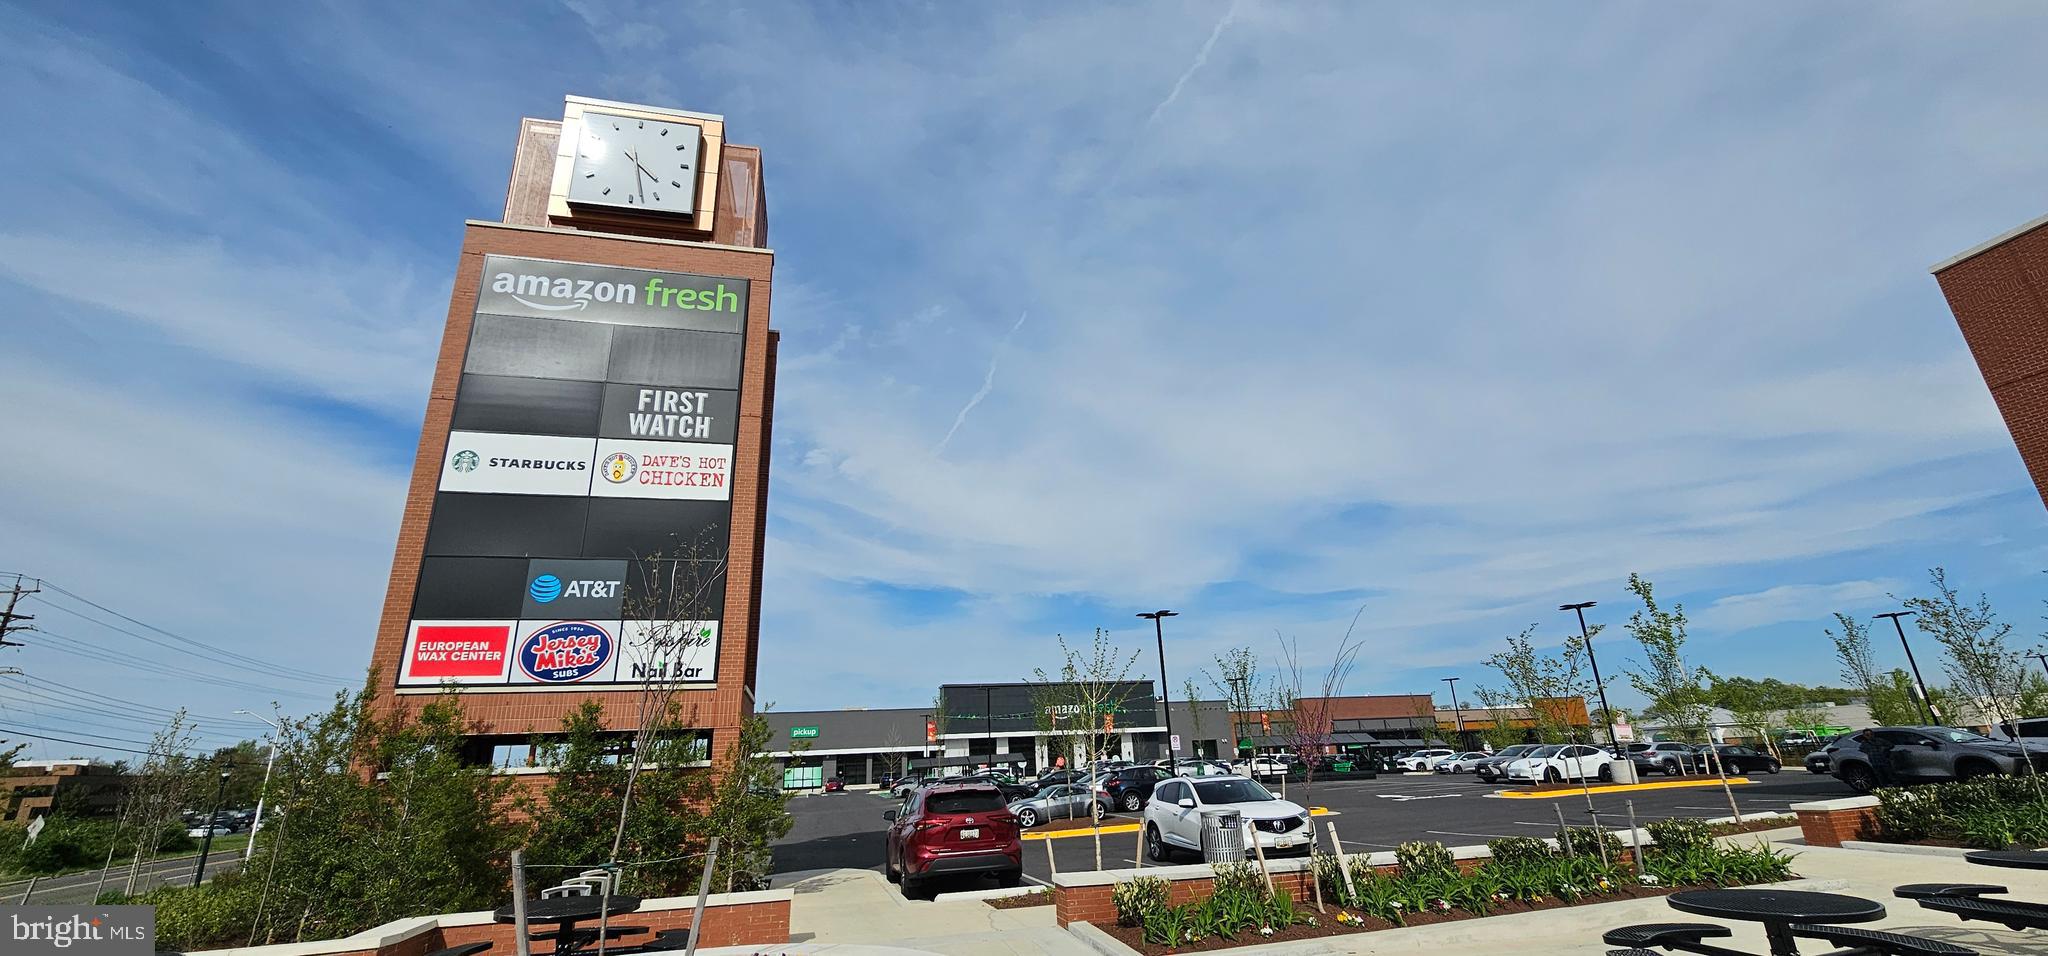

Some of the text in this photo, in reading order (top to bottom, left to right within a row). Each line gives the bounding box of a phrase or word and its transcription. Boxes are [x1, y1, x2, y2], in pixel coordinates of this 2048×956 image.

[492, 272, 738, 312] amazon fresh
[638, 389, 709, 414] FIRST
[629, 413, 711, 438] WATCH
[489, 457, 586, 471] STARBUCKS
[642, 455, 726, 469] DAVE'S HOT
[640, 470, 725, 487] CHICKEN
[563, 580, 621, 598] AT&T
[551, 626, 569, 634] SINCE
[418, 641, 490, 651] EUROPEAN
[531, 634, 601, 653] Jersey
[417, 651, 502, 661] WAX CENTER
[534, 648, 599, 672] Mike's
[552, 668, 579, 679] SUBS
[632, 661, 703, 679] Nail Bar
[793, 728, 817, 738] pickup
